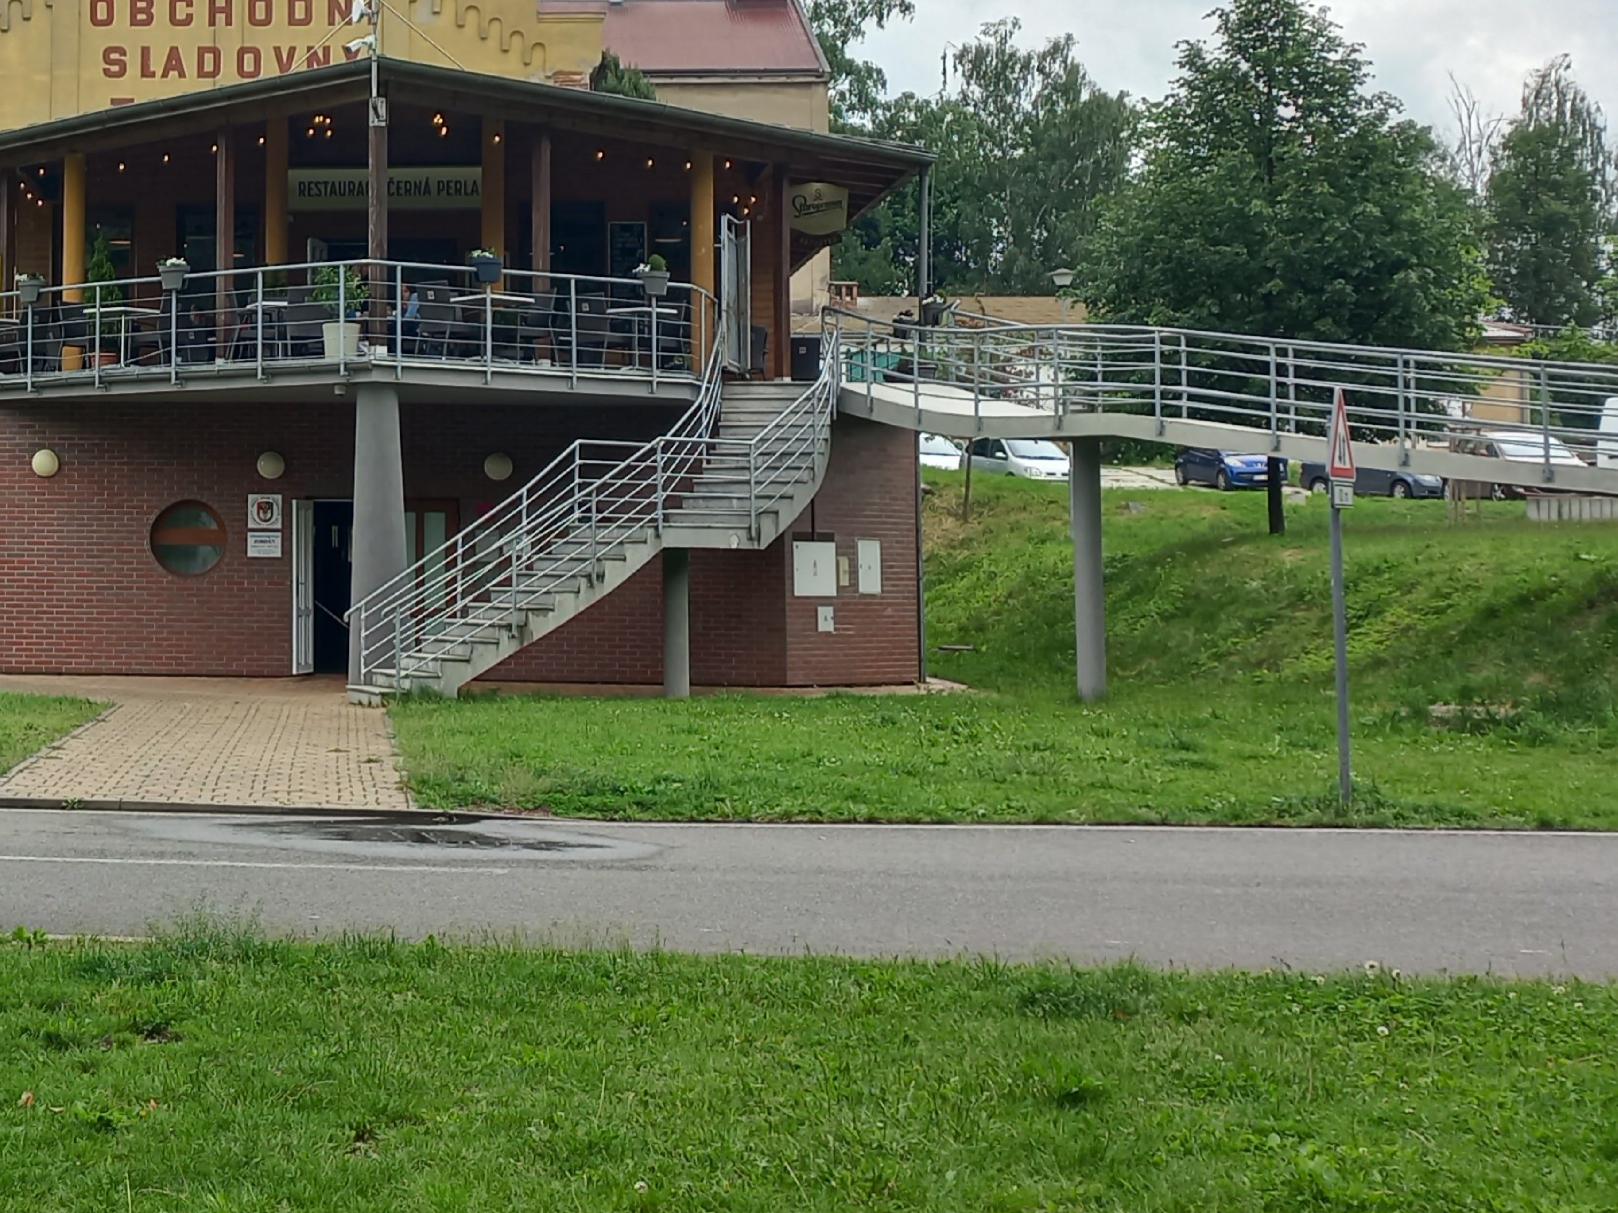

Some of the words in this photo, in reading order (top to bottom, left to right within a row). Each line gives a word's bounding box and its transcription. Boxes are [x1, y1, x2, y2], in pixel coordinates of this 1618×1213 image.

[298, 180, 369, 197] RESTAURA
[387, 177, 432, 197] ČERNÁ
[437, 179, 480, 197] PERLA
